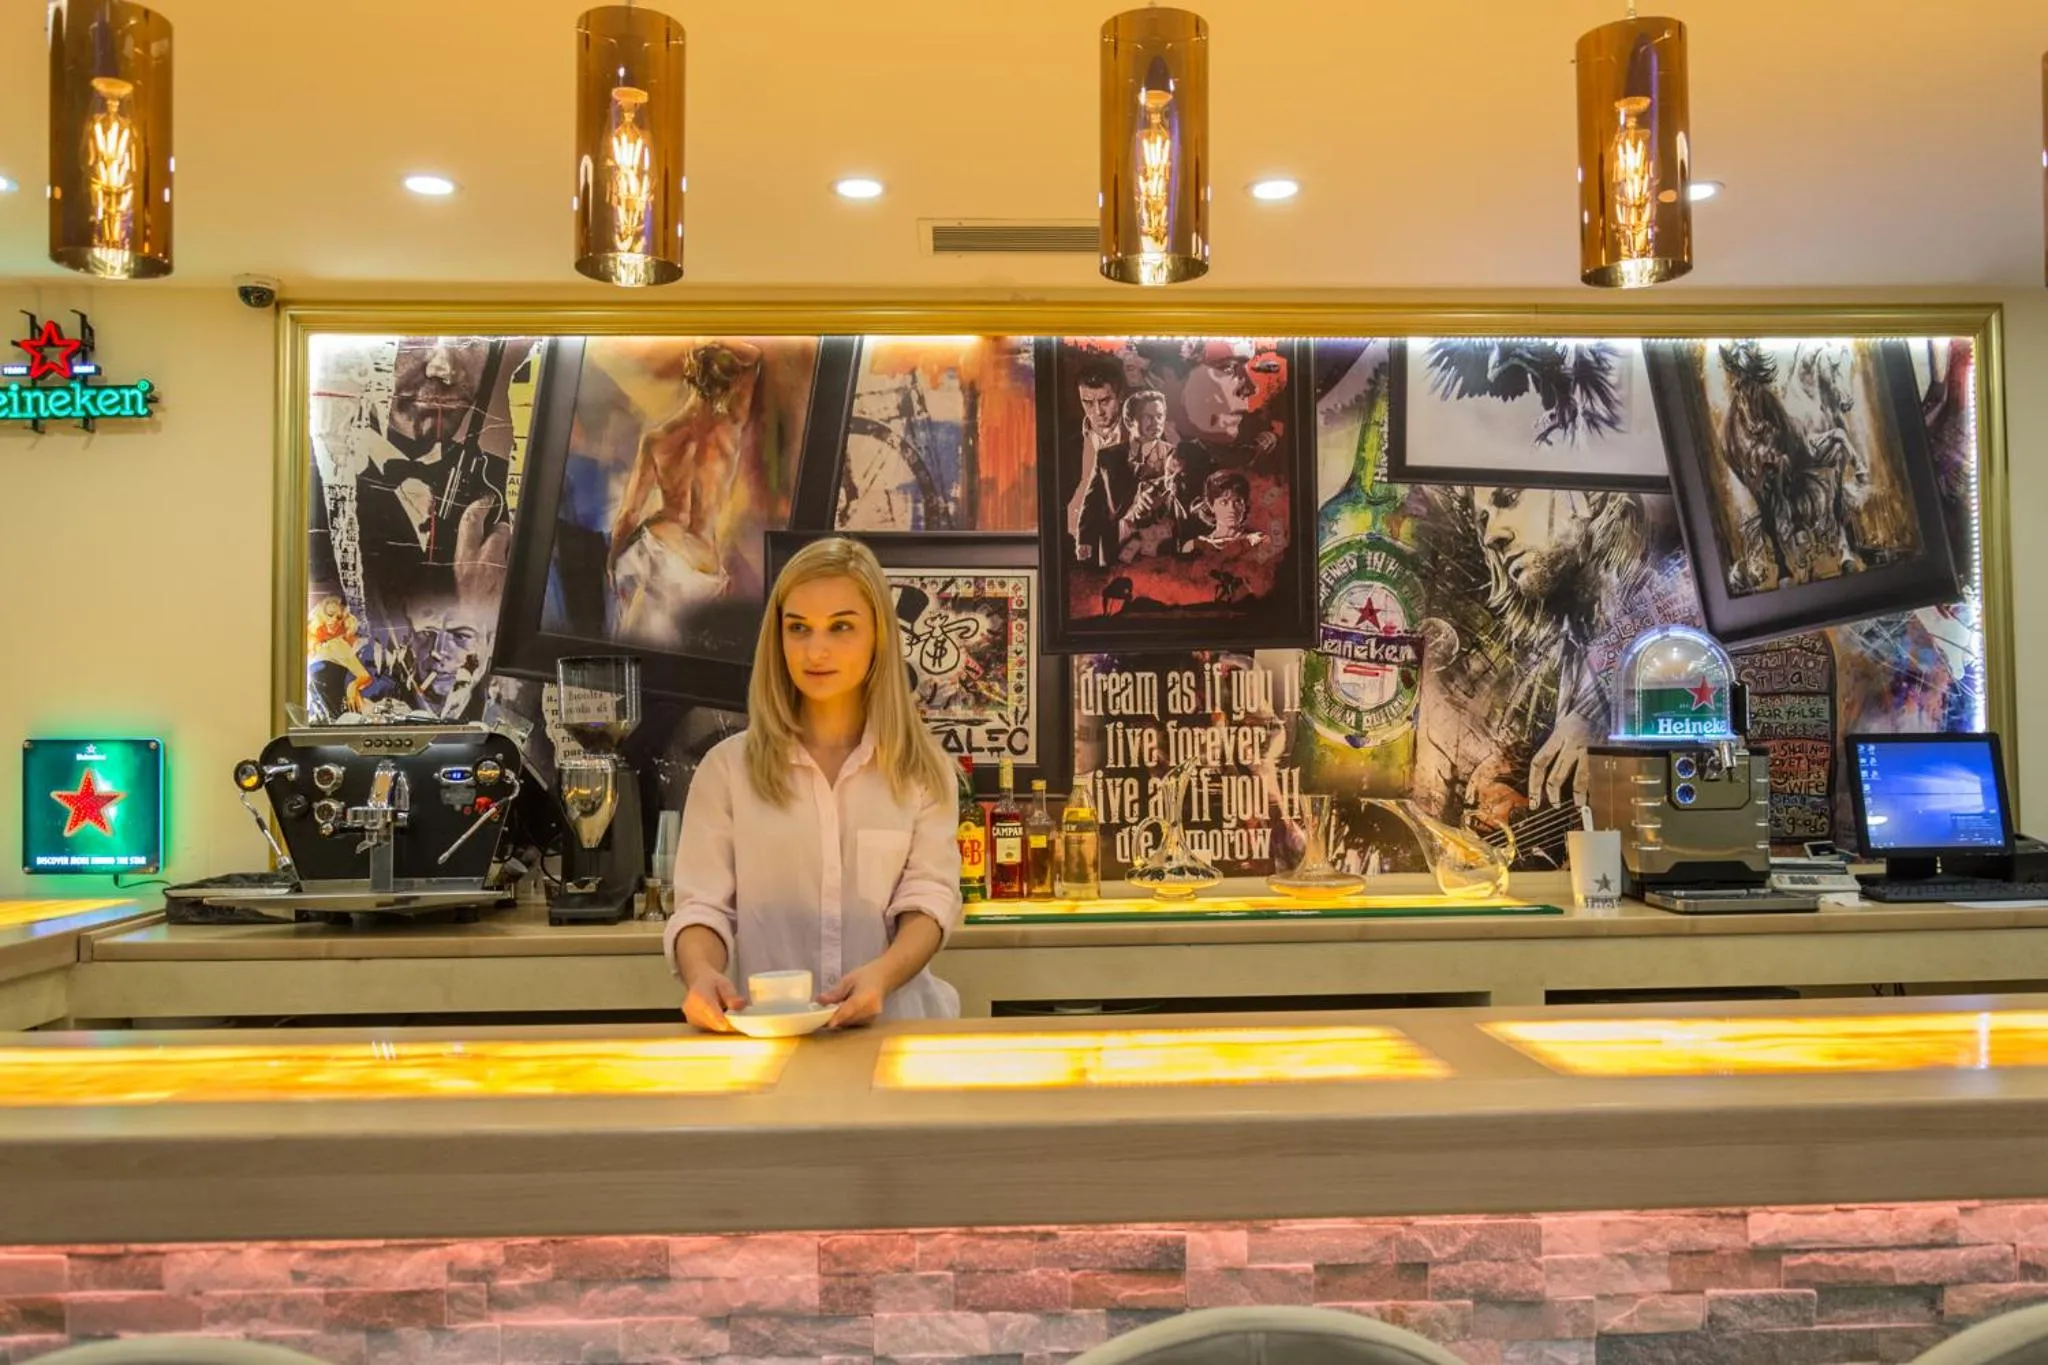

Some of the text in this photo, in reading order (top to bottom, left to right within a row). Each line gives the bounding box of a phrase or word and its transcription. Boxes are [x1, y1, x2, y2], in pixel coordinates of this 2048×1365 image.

[1080, 665, 1159, 721] dream
[1167, 670, 1196, 715] as
[1204, 662, 1224, 715] if
[1231, 664, 1275, 721] you
[1105, 719, 1267, 769] live forever
[1190, 766, 1217, 822] if
[1221, 774, 1270, 830] you
[1115, 827, 1272, 864] die morow
